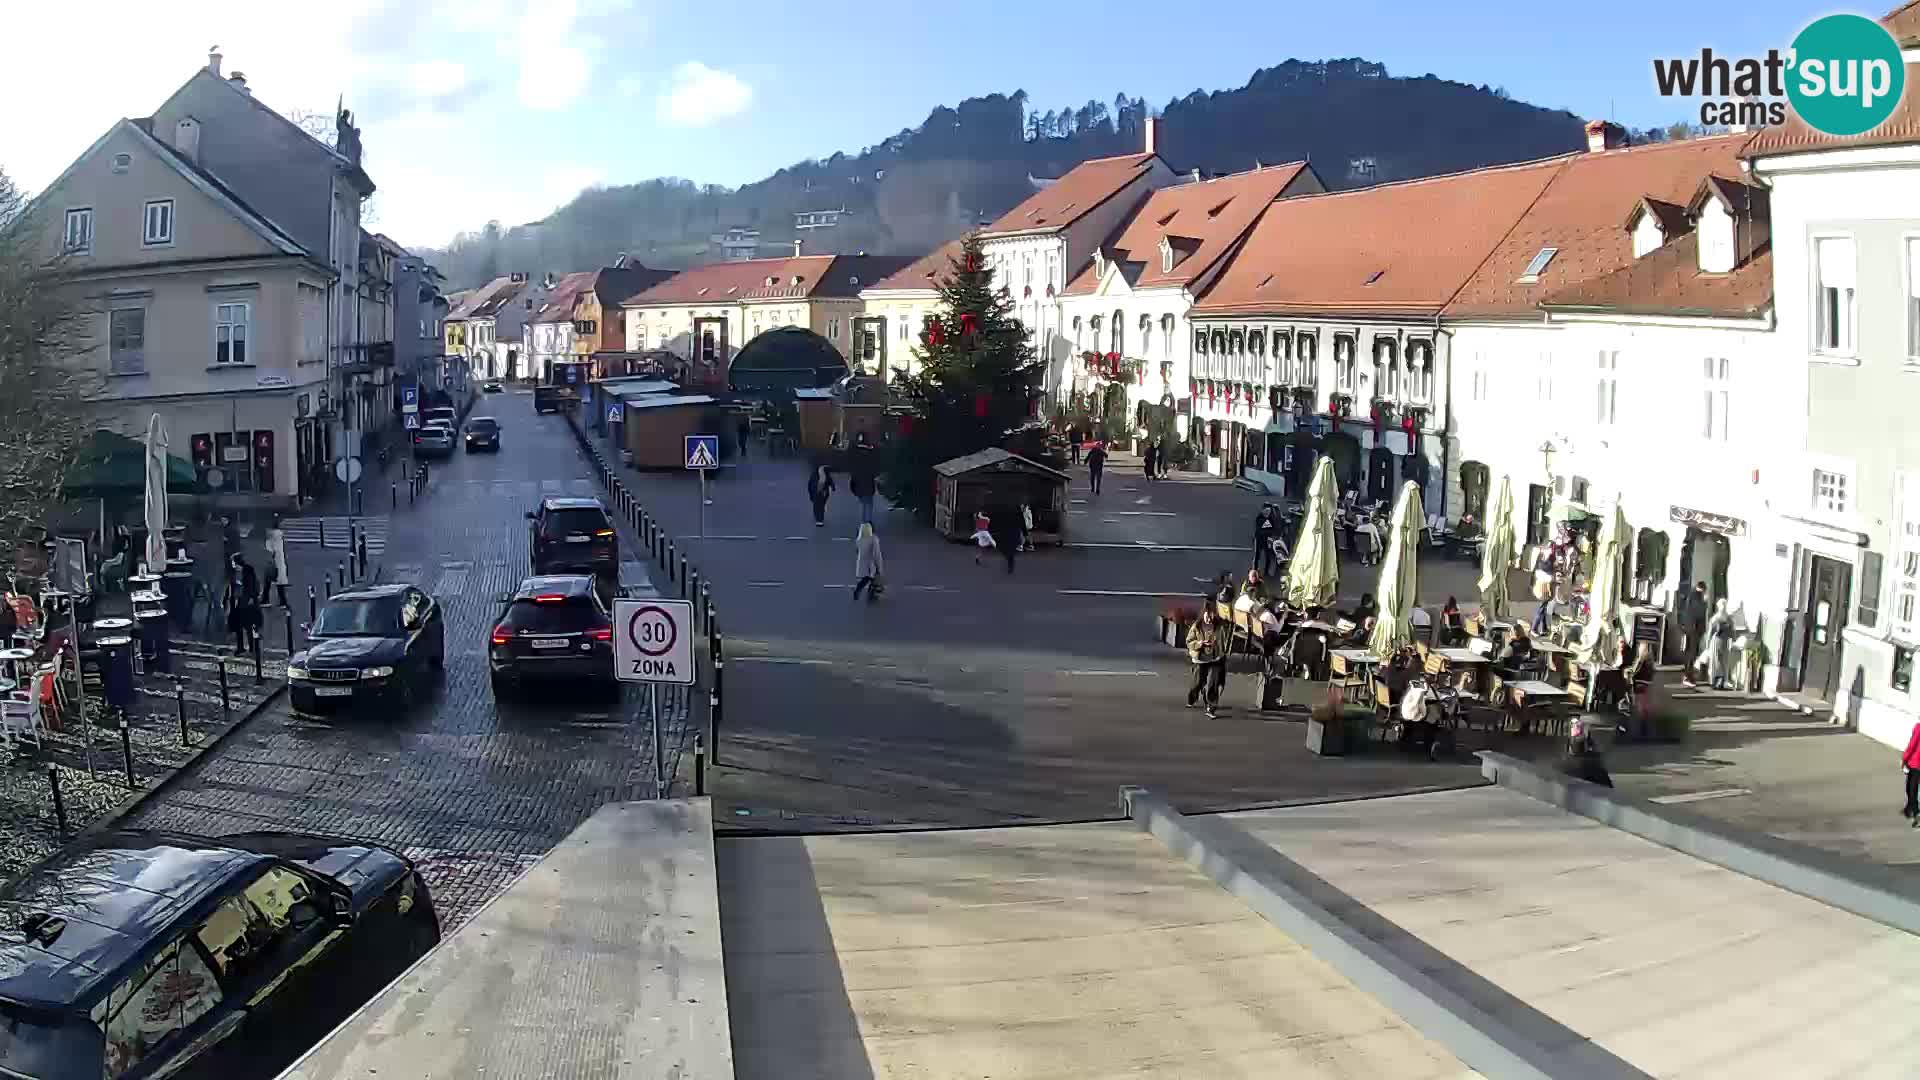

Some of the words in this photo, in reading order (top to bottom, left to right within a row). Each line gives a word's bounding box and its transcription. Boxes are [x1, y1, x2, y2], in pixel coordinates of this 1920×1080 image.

[406, 391, 414, 401] P
[642, 622, 666, 643] 30
[631, 659, 676, 677] ZONA
